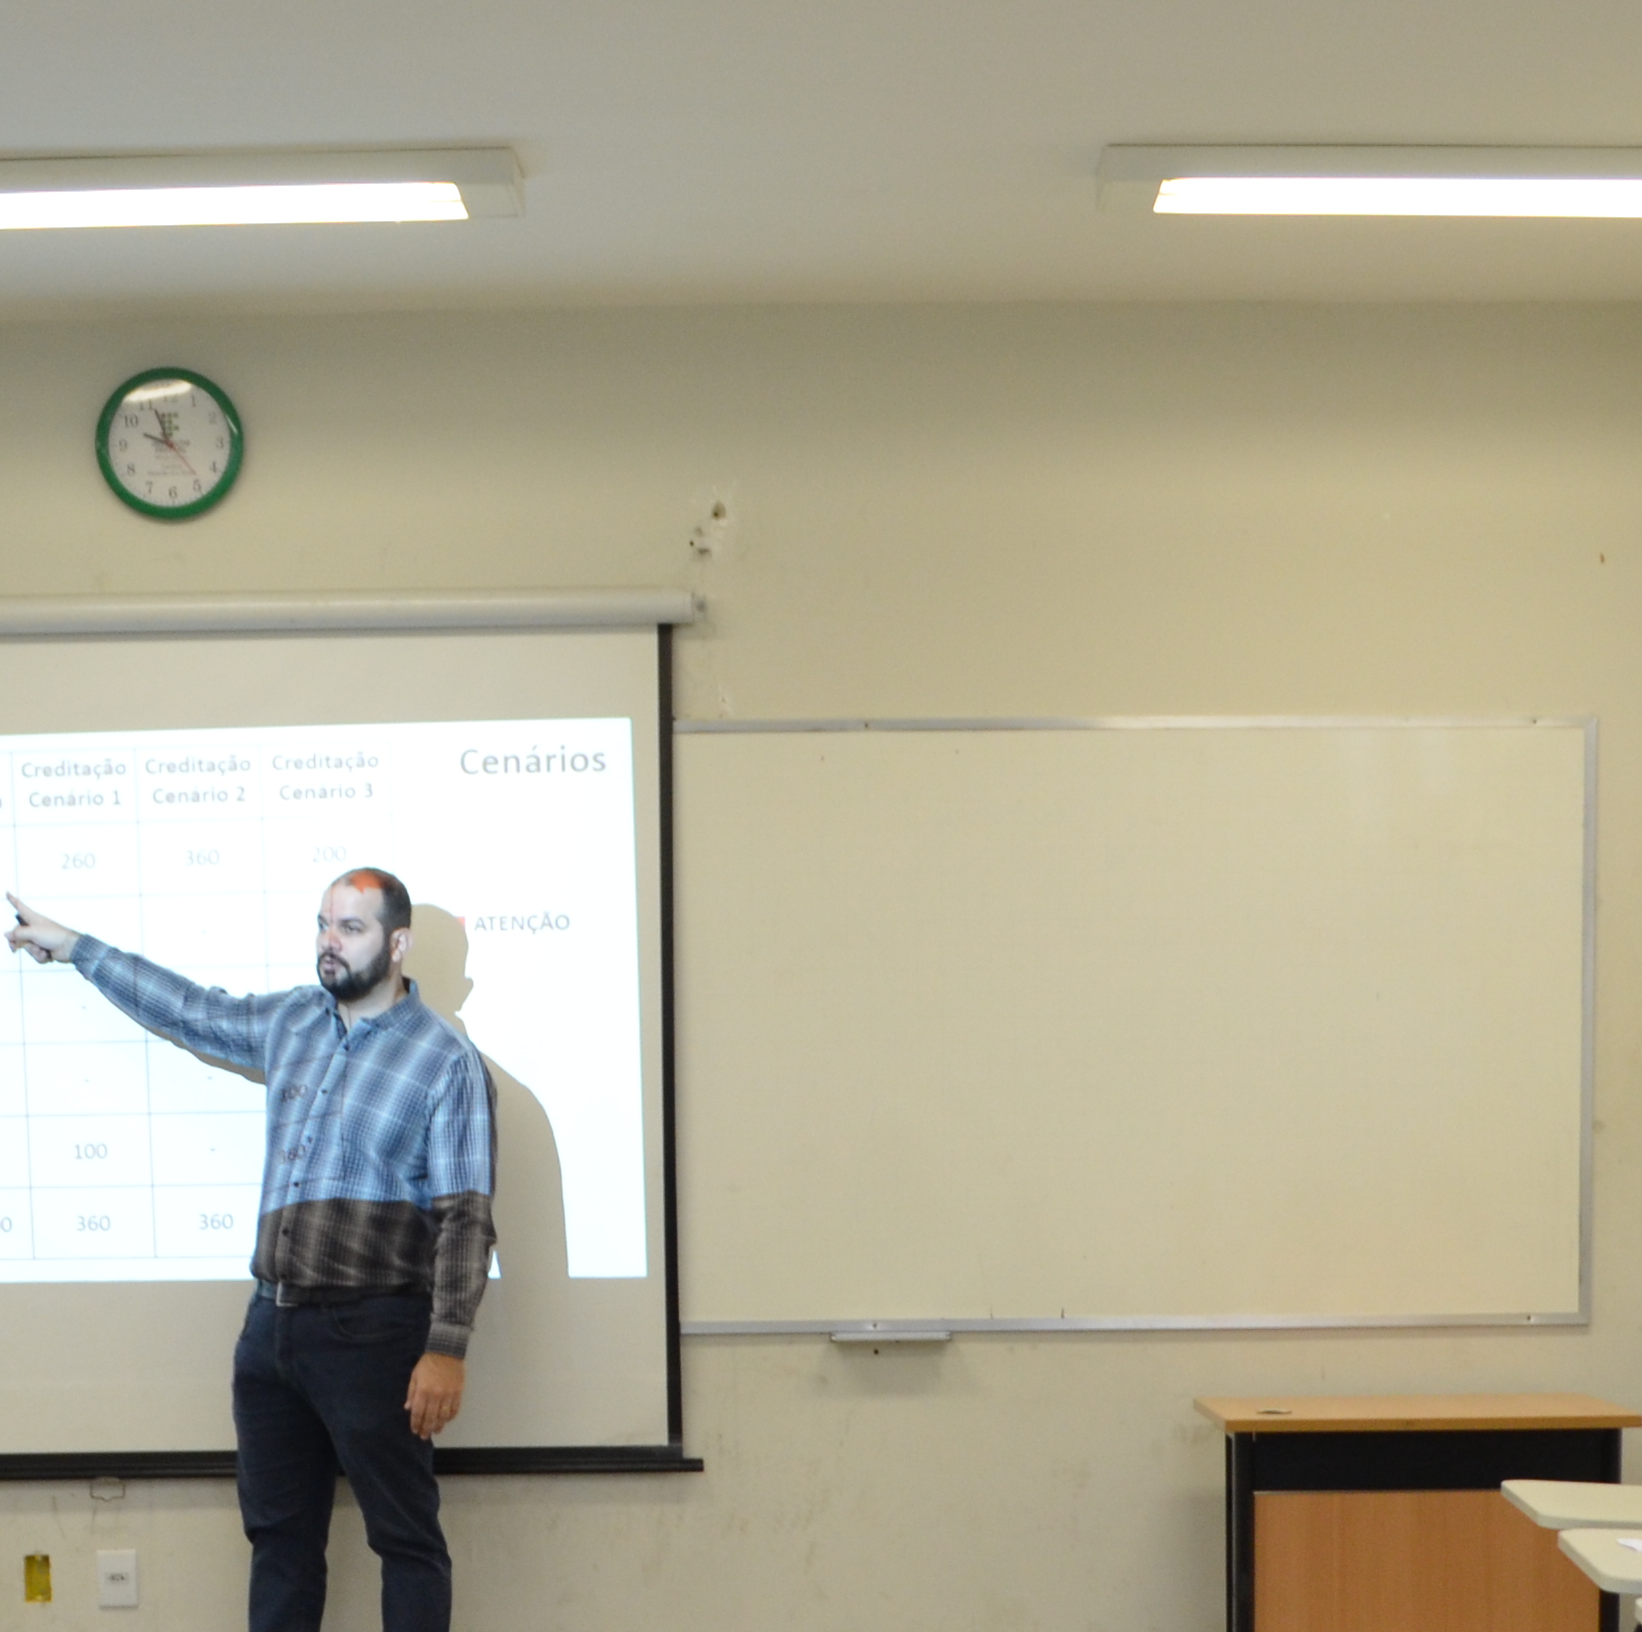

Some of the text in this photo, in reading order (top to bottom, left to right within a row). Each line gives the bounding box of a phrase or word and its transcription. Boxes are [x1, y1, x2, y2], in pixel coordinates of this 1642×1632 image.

[124, 414, 139, 428] 10
[119, 439, 127, 452] 9
[216, 437, 224, 449] 3
[127, 463, 135, 476] 8
[145, 481, 153, 494] 7
[168, 486, 177, 498] 6
[21, 757, 127, 781] Creditação
[145, 753, 252, 777] Creditação
[272, 750, 380, 773] Creditação
[459, 744, 607, 775] Cenários
[28, 789, 122, 809] Cenário 1
[152, 785, 246, 805] Cenário 2
[279, 782, 374, 801] Cenário 3
[60, 851, 97, 871] 260
[185, 848, 221, 867] 360
[311, 845, 347, 864] 200
[473, 910, 571, 936] ATENÇÃO
[74, 1142, 109, 1161] 100
[76, 1214, 112, 1232] 360
[198, 1212, 235, 1231] 360
